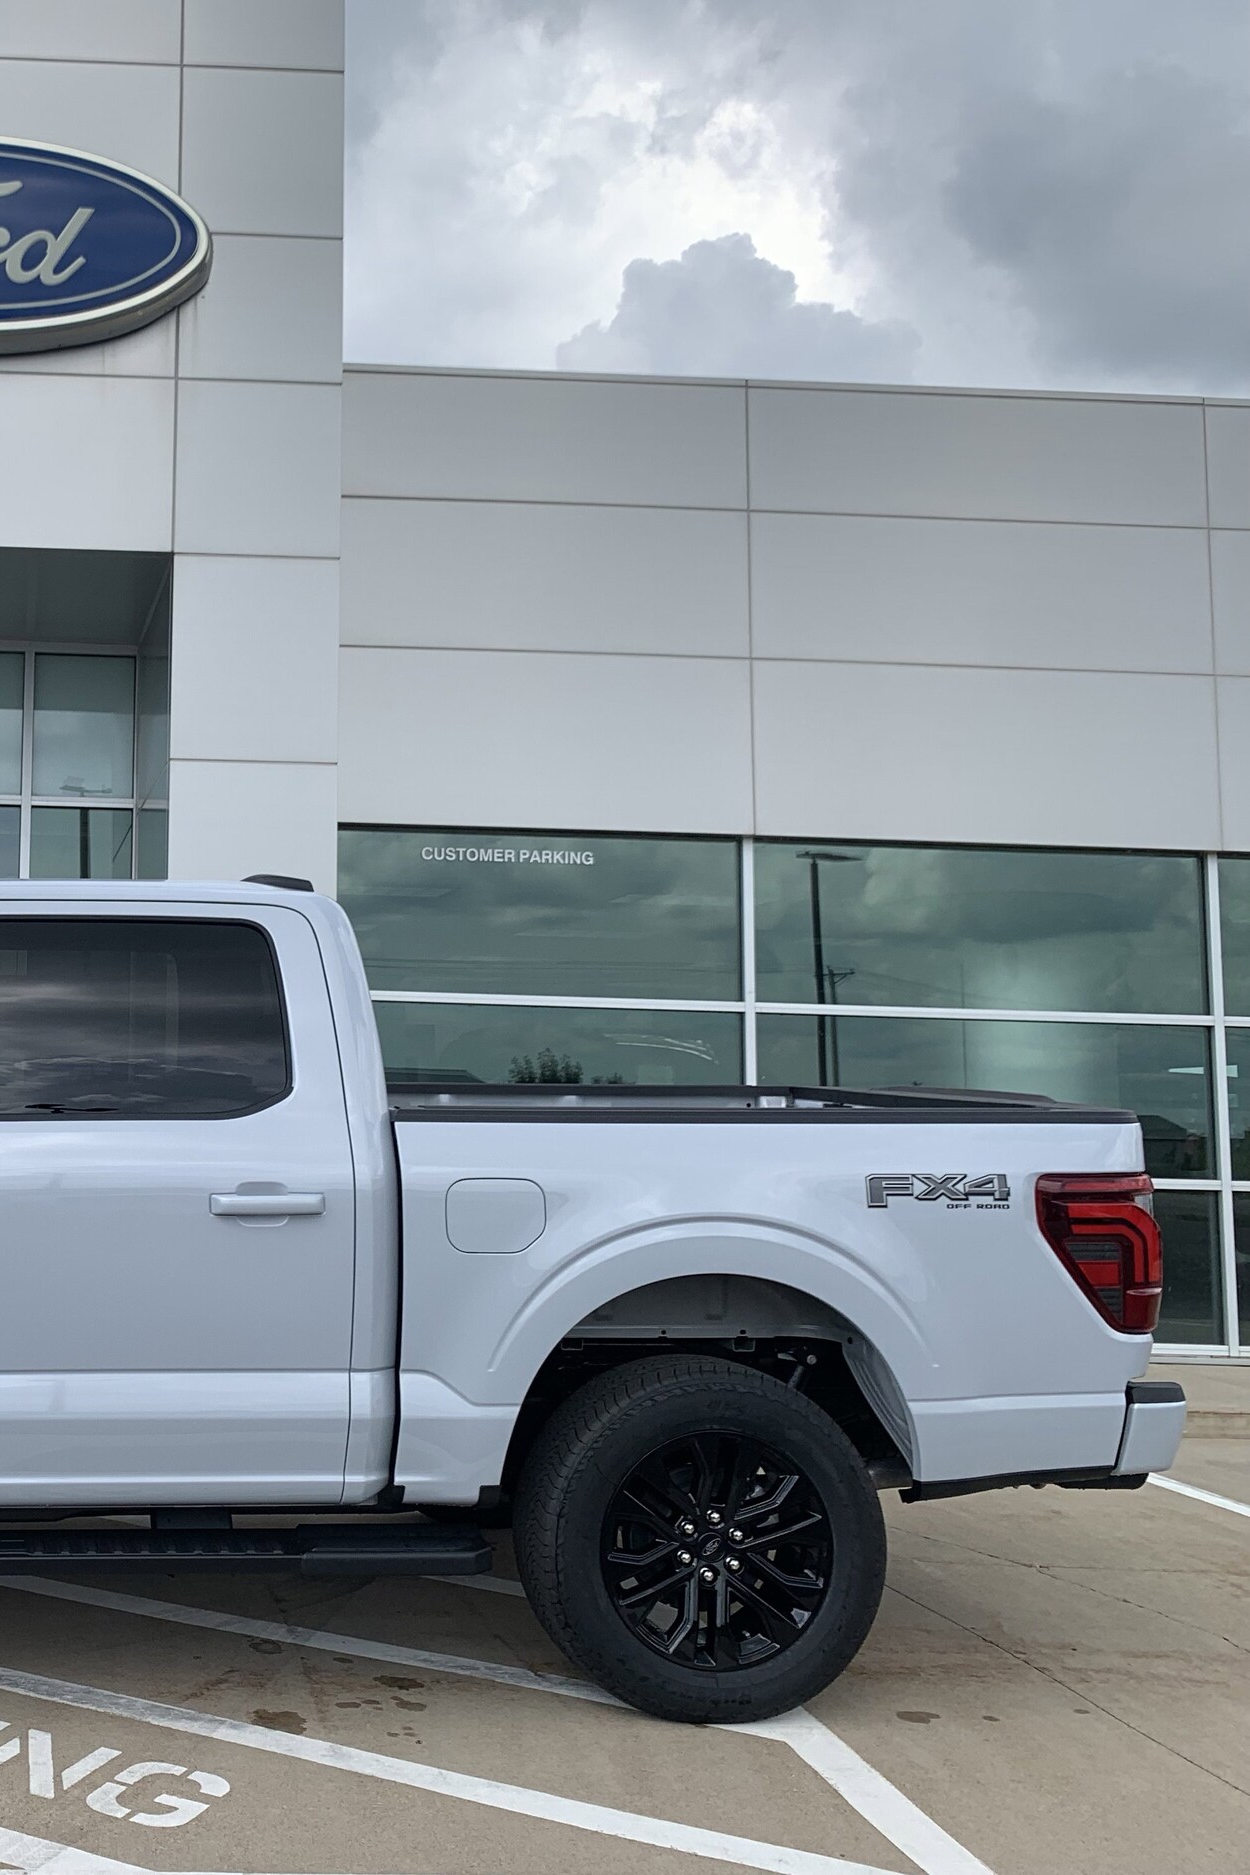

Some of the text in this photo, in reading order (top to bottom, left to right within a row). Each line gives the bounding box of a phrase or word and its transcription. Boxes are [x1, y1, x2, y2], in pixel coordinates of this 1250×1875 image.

[422, 847, 594, 865] CUSTOMER PARKING
[865, 1173, 1011, 1208] FX4
